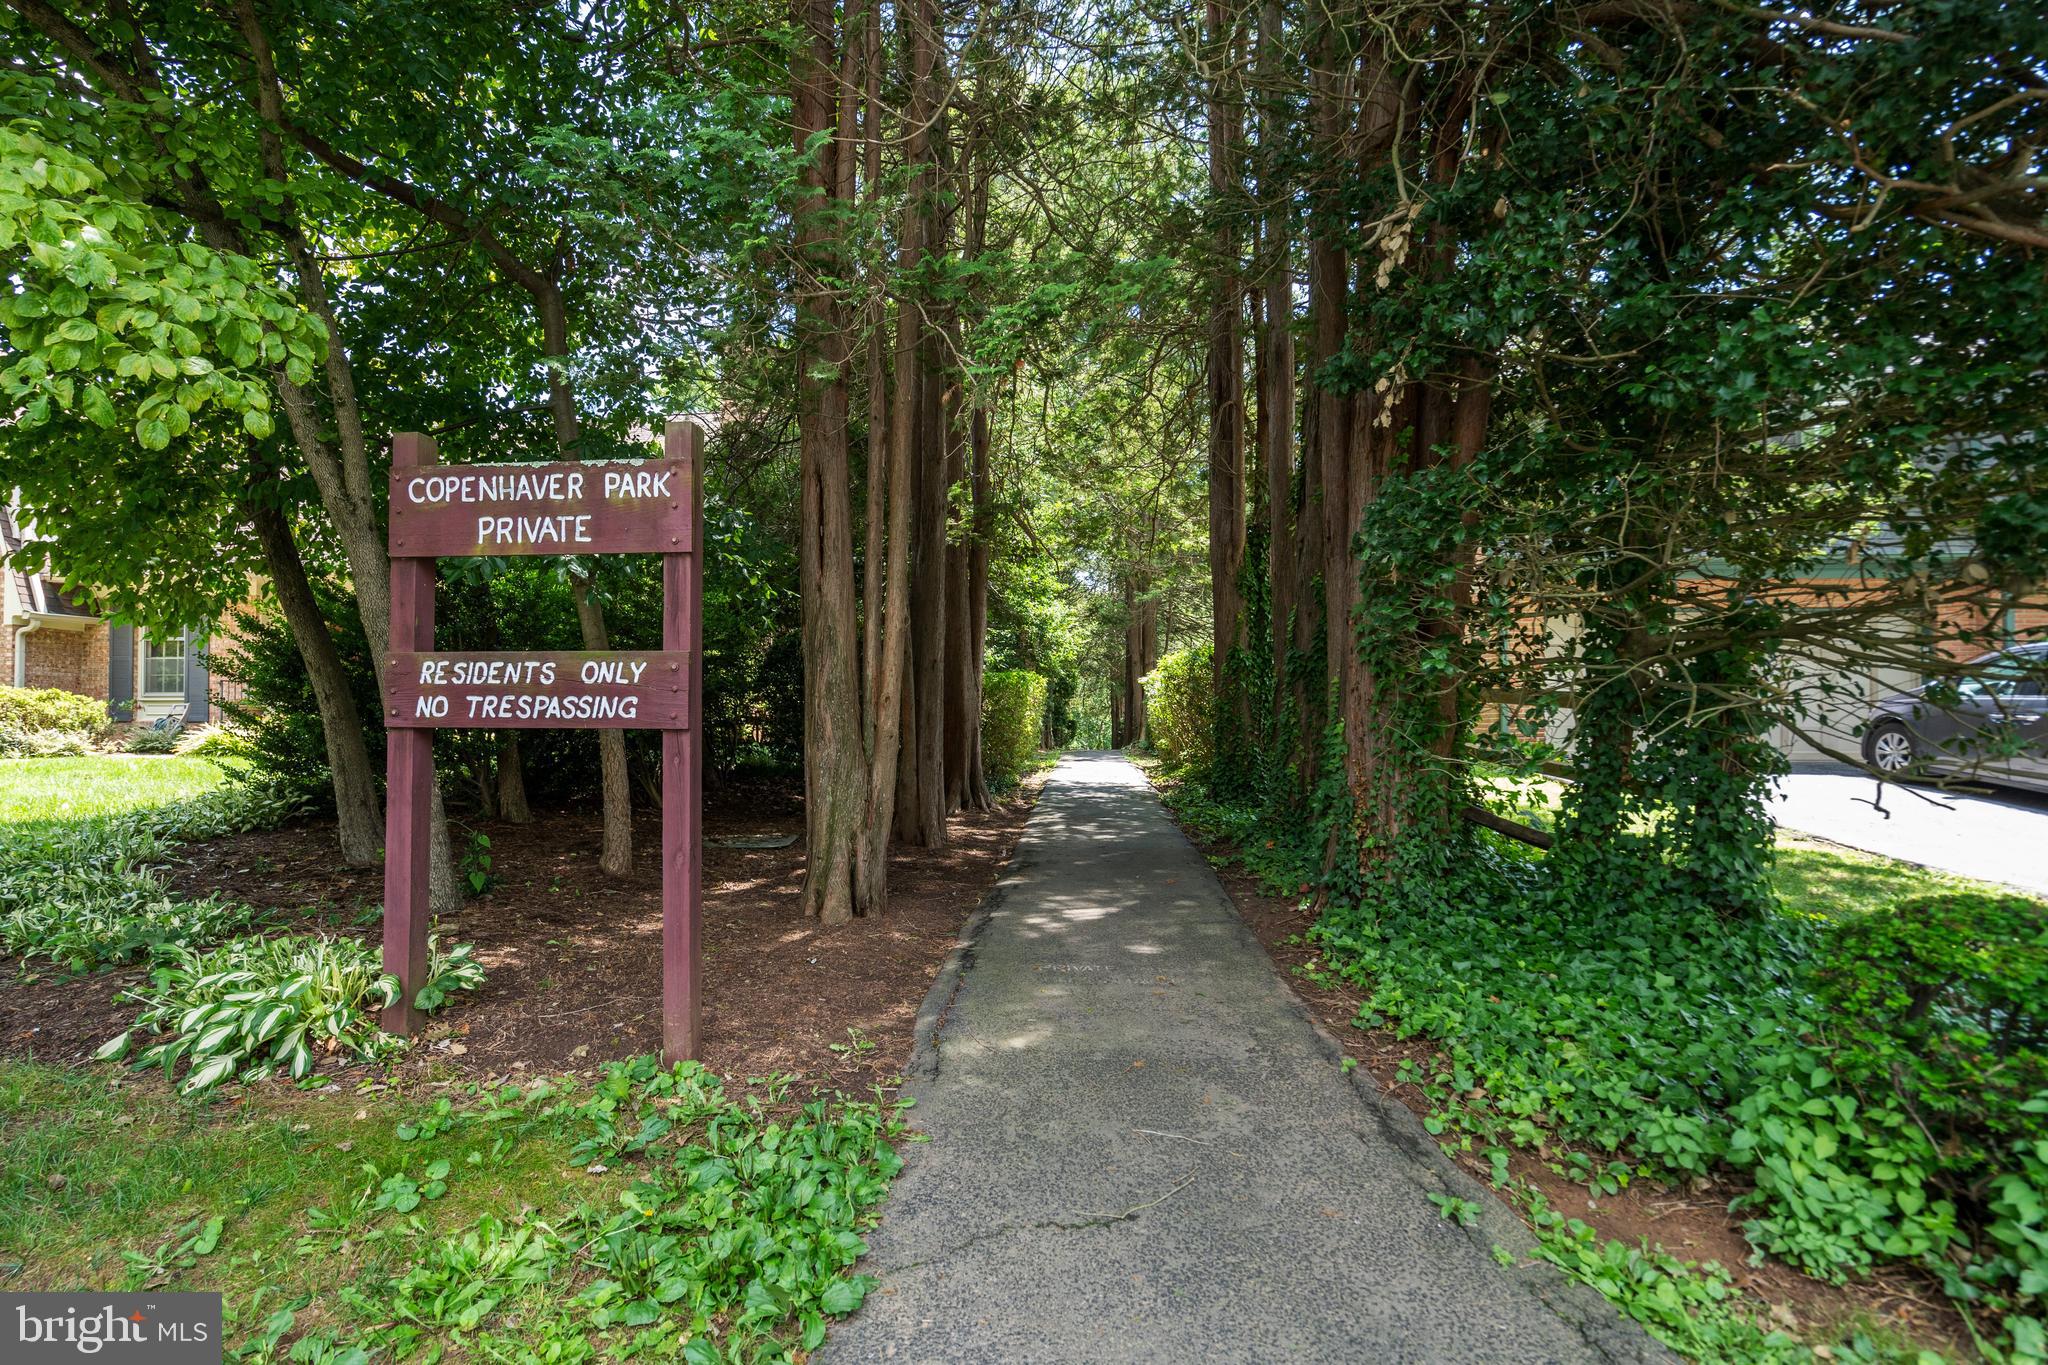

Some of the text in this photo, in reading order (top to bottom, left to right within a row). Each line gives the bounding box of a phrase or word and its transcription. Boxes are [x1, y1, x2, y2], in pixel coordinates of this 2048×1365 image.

[408, 471, 671, 504] COPENHAVER PARK
[477, 514, 592, 545] PRIVATE
[419, 660, 648, 685] RESIDENTS ONLY
[415, 694, 639, 720] NO TRESPASSING
